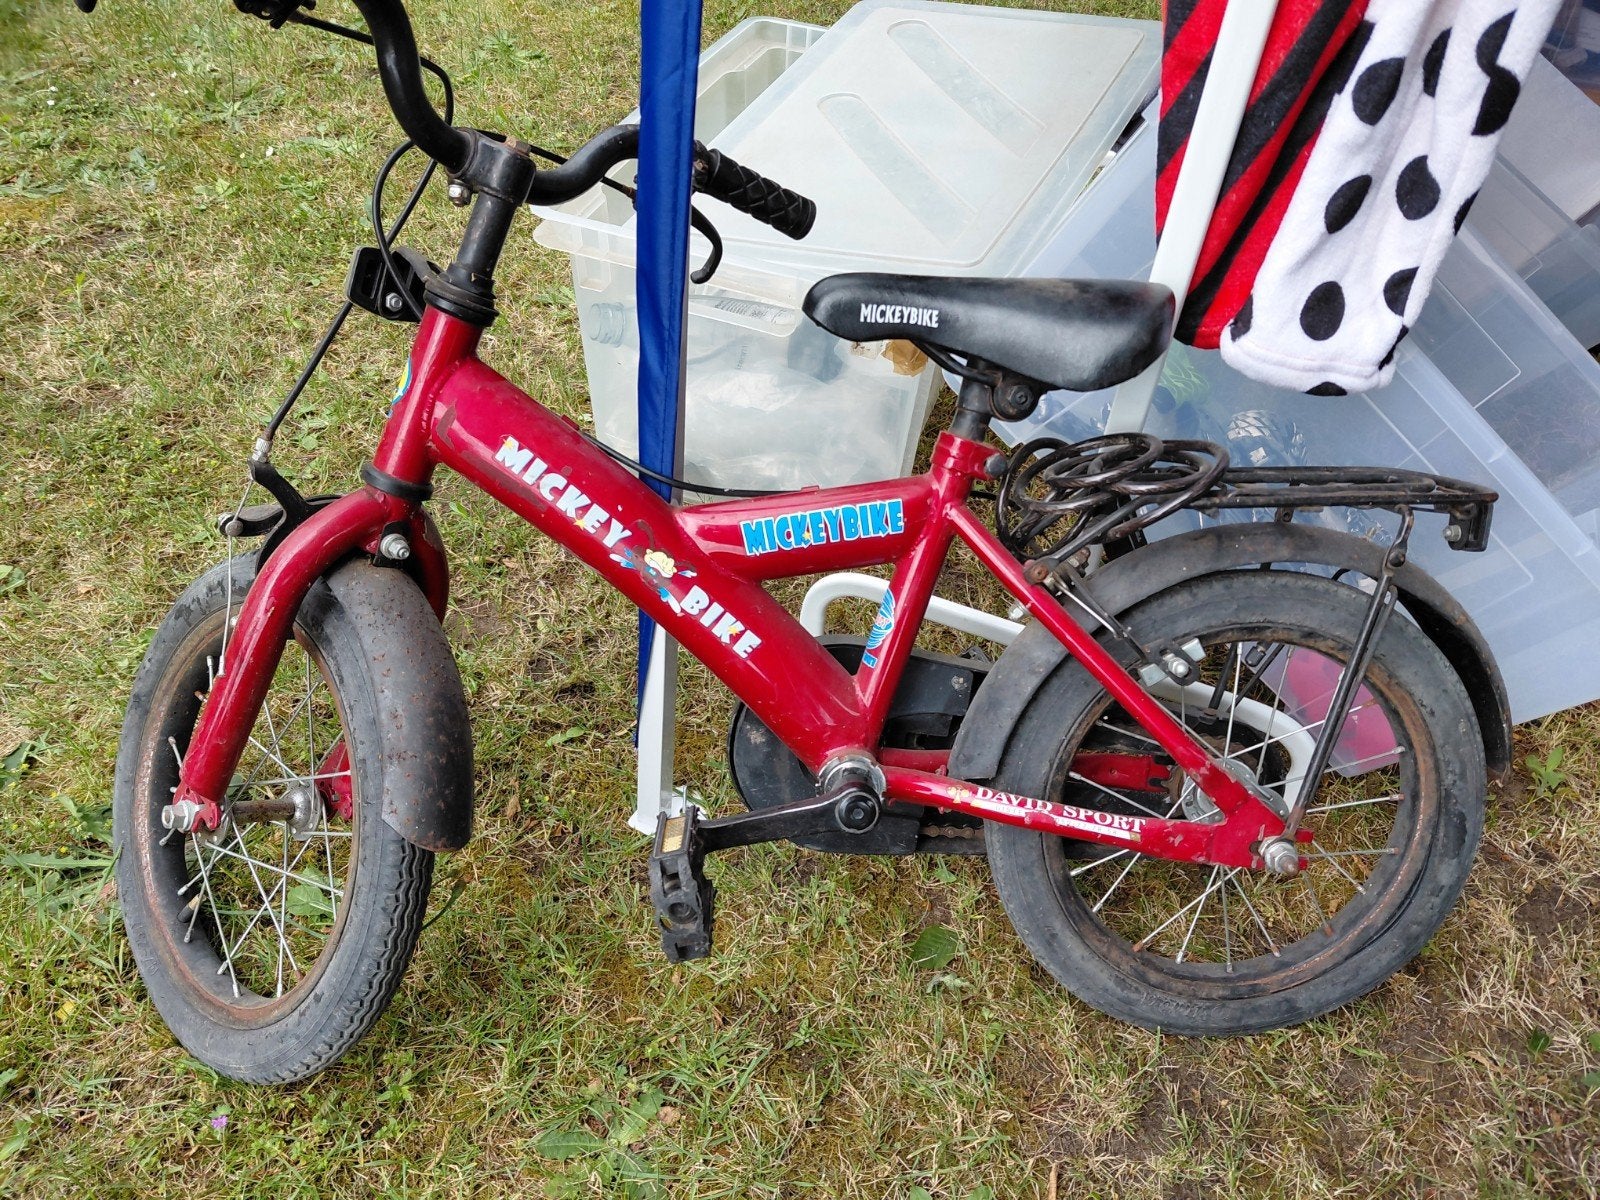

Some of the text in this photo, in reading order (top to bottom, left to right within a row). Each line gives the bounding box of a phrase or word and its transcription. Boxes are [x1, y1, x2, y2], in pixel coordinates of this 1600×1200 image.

[860, 303, 939, 328] MICKEYBIKE
[495, 435, 762, 659] MICKEY BIKE
[739, 498, 905, 556] MICKEYBIKE
[975, 786, 1052, 813] DAVID
[1063, 805, 1146, 832] SPORT
